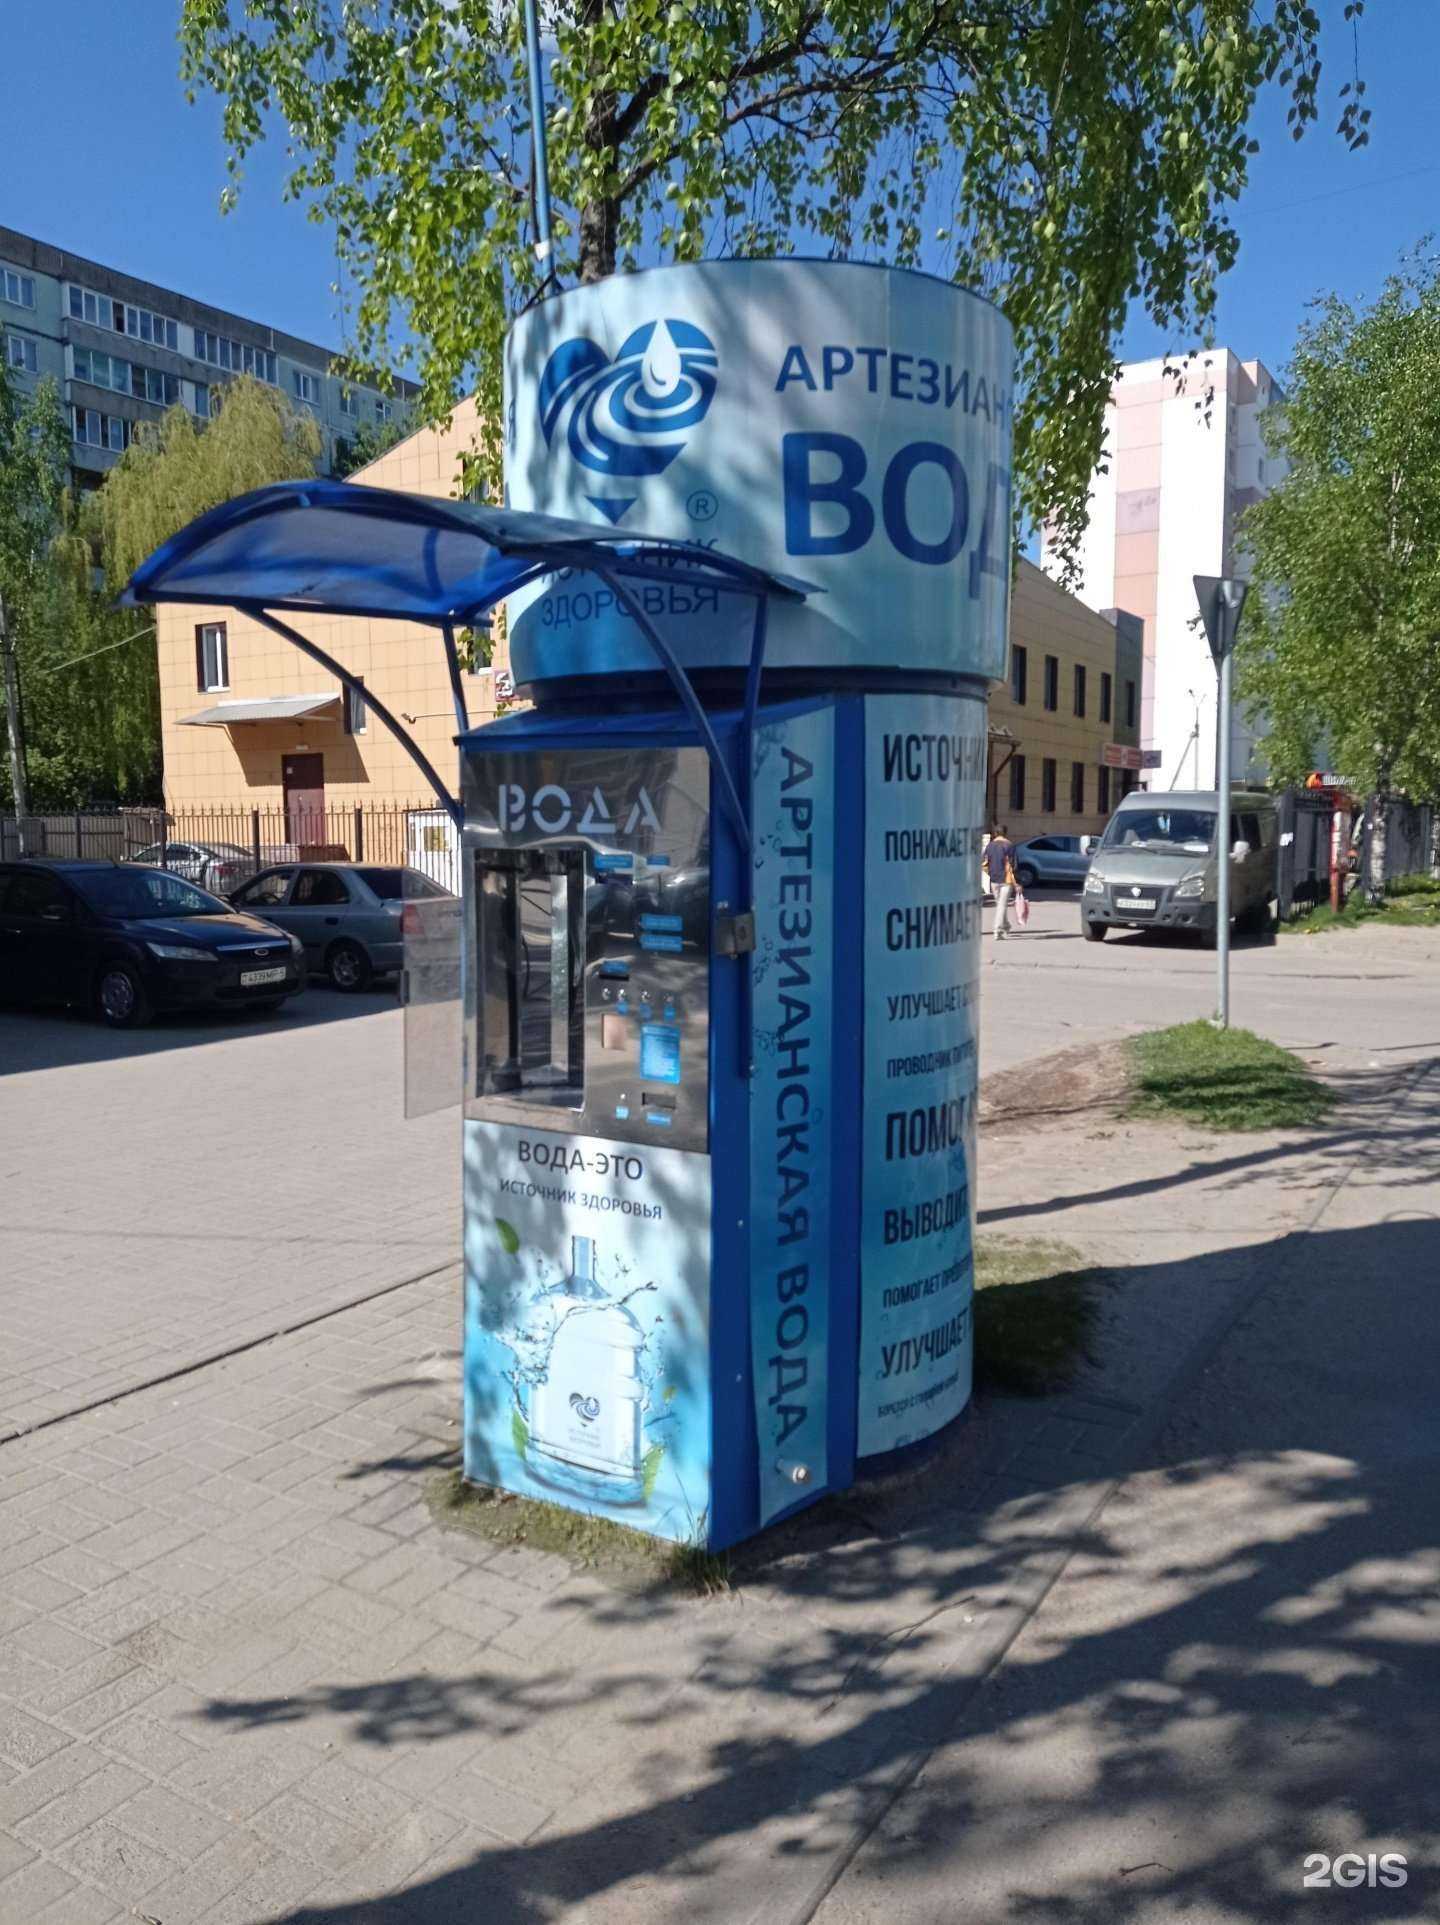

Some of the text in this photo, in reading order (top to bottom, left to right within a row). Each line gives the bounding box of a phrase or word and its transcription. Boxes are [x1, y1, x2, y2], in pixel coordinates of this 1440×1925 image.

[499, 784, 660, 833] ВОДА
[885, 828, 968, 862] ПОНИЖАЕТ
[888, 984, 961, 1021] УЛУЧШАЕТ
[768, 746, 814, 1446] АРТЕЗИАНСКАЯ ВОДА
[518, 1140, 643, 1181] ВОДА-ЭТО
[500, 1178, 662, 1220] ИСТОЧНИК ЗДОРОВЬЯ
